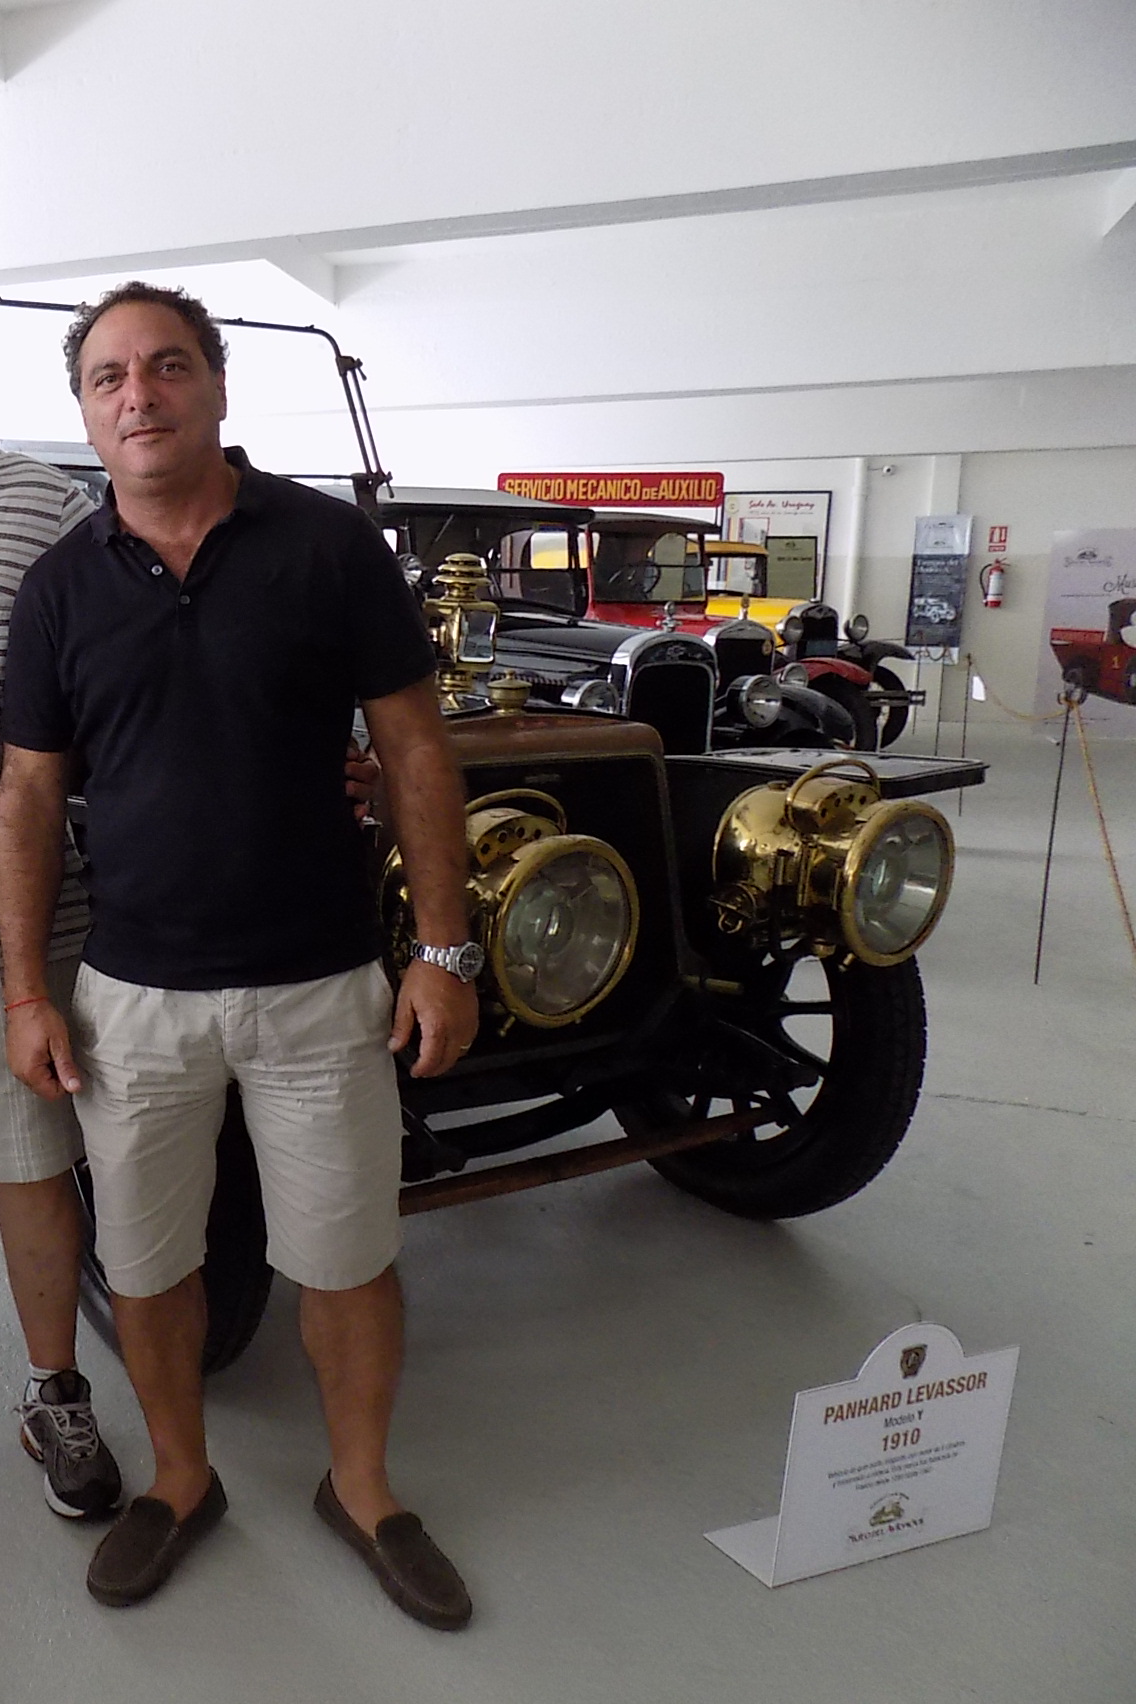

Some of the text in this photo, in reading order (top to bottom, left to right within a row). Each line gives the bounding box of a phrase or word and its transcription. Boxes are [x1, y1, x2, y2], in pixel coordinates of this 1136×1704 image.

[504, 478, 564, 501] SERVICIO
[565, 478, 641, 501] MECANICO
[658, 479, 716, 501] AUXILIO
[823, 1371, 988, 1425] PANHARD LEVASSOR
[884, 1410, 924, 1428] Modelo Y
[882, 1428, 921, 1452] 1910
